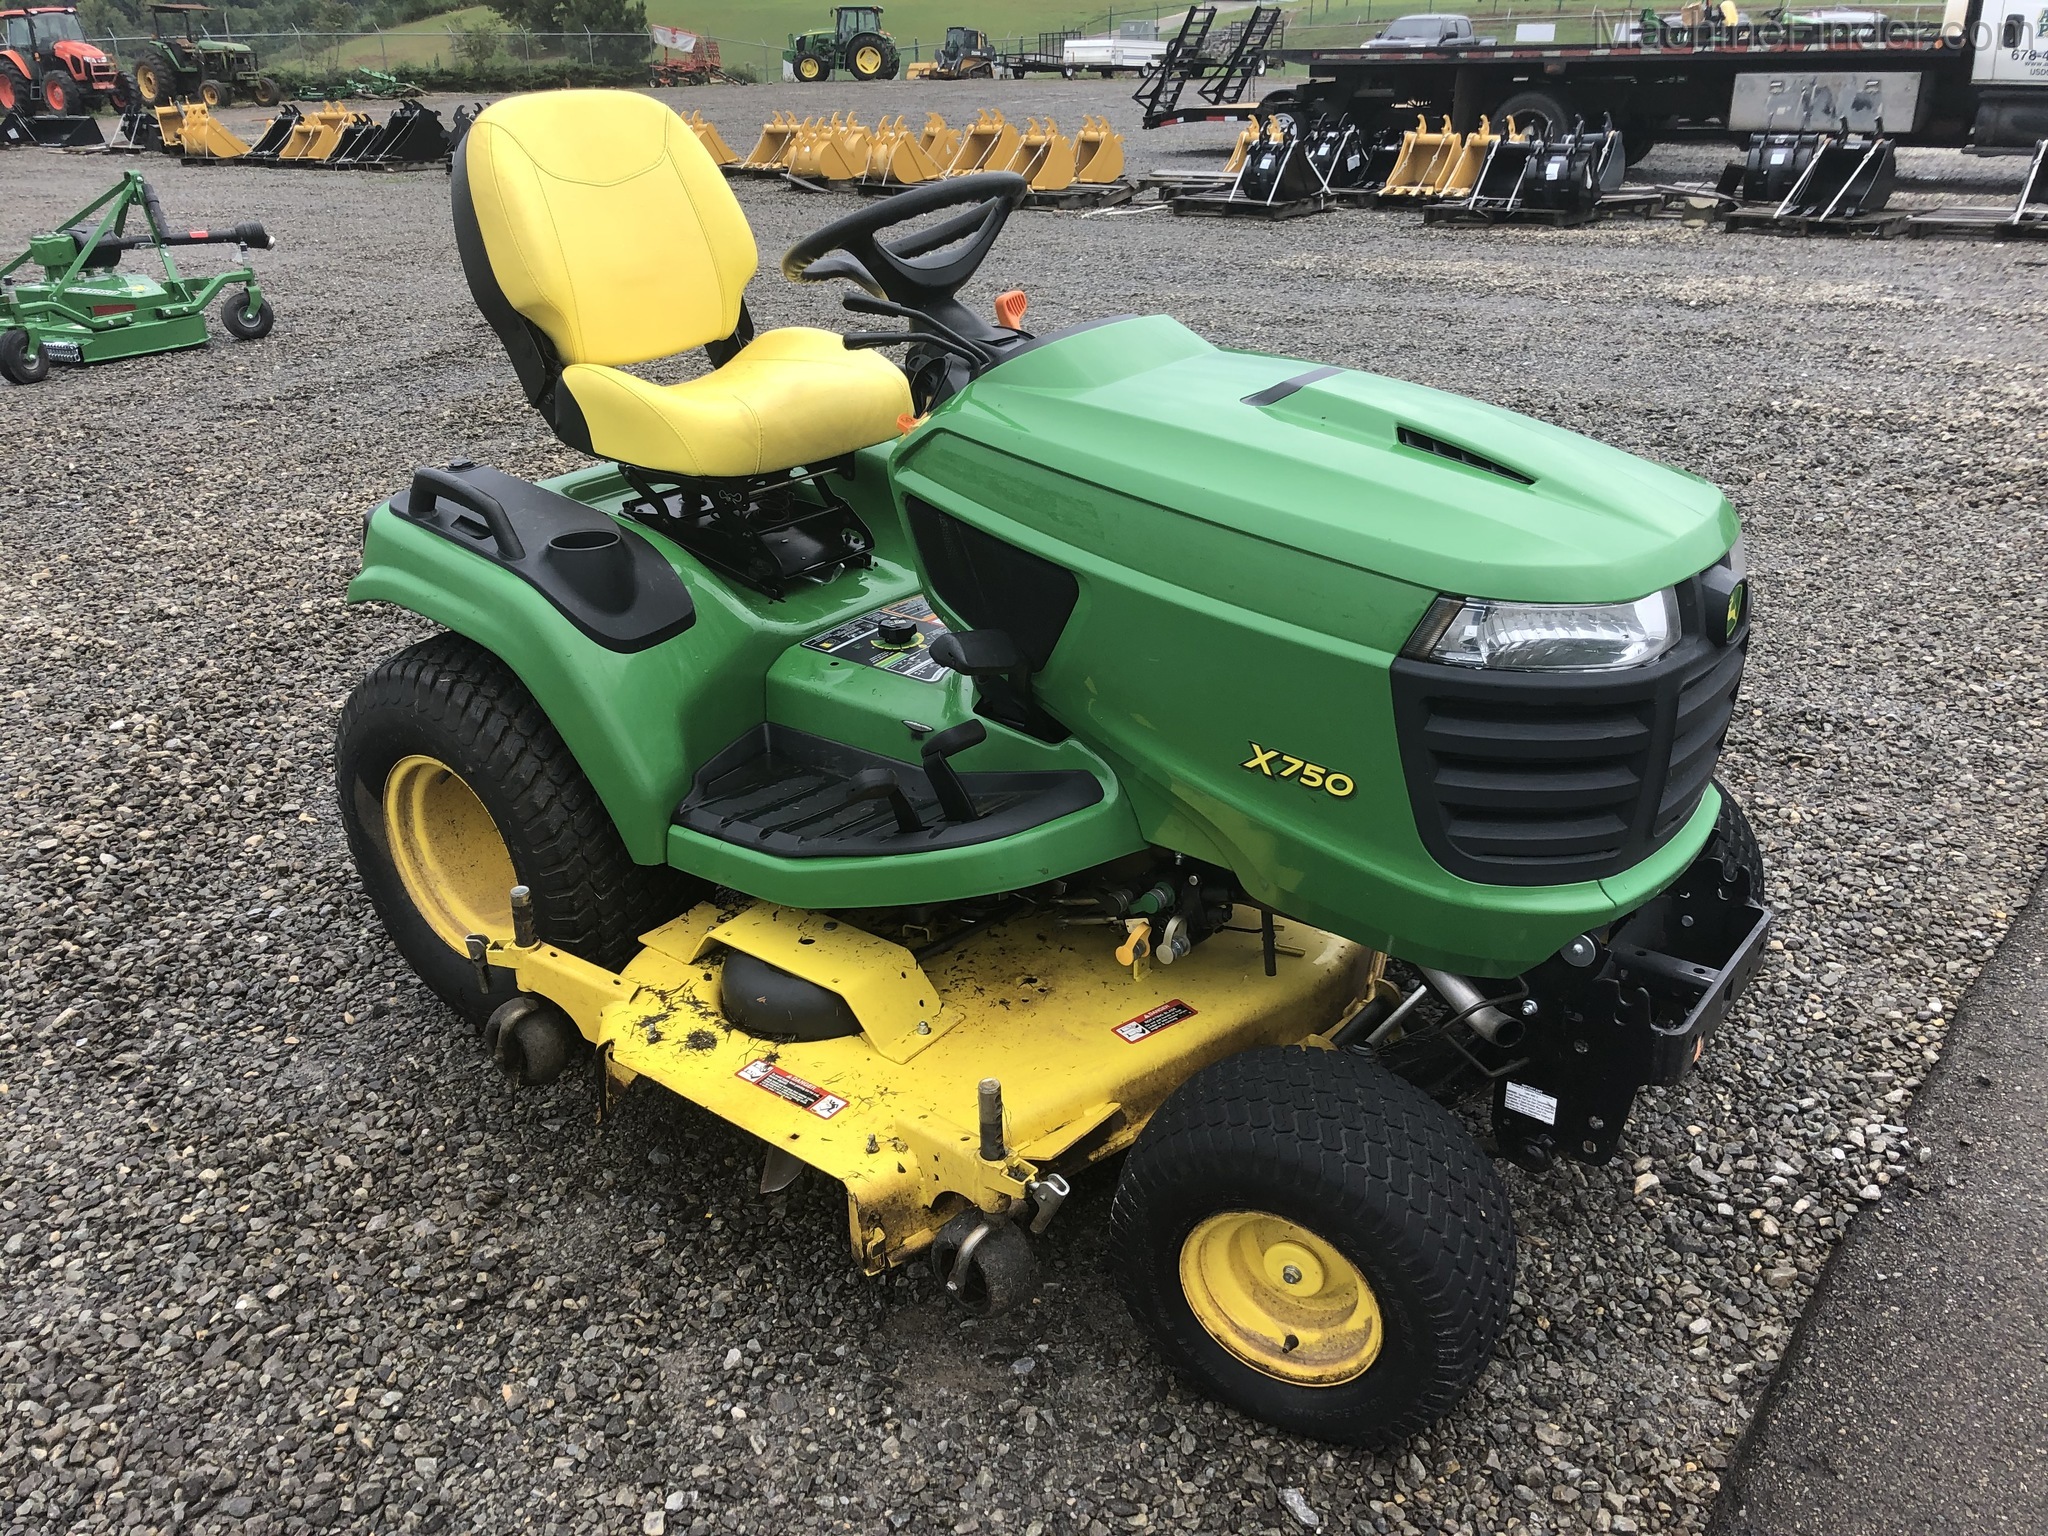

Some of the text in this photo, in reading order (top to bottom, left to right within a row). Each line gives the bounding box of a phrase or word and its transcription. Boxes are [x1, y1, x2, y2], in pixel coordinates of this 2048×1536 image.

[1240, 741, 1356, 799] X750
[1148, 1004, 1170, 1017] DANGER
[790, 1075, 817, 1090] DANGER
